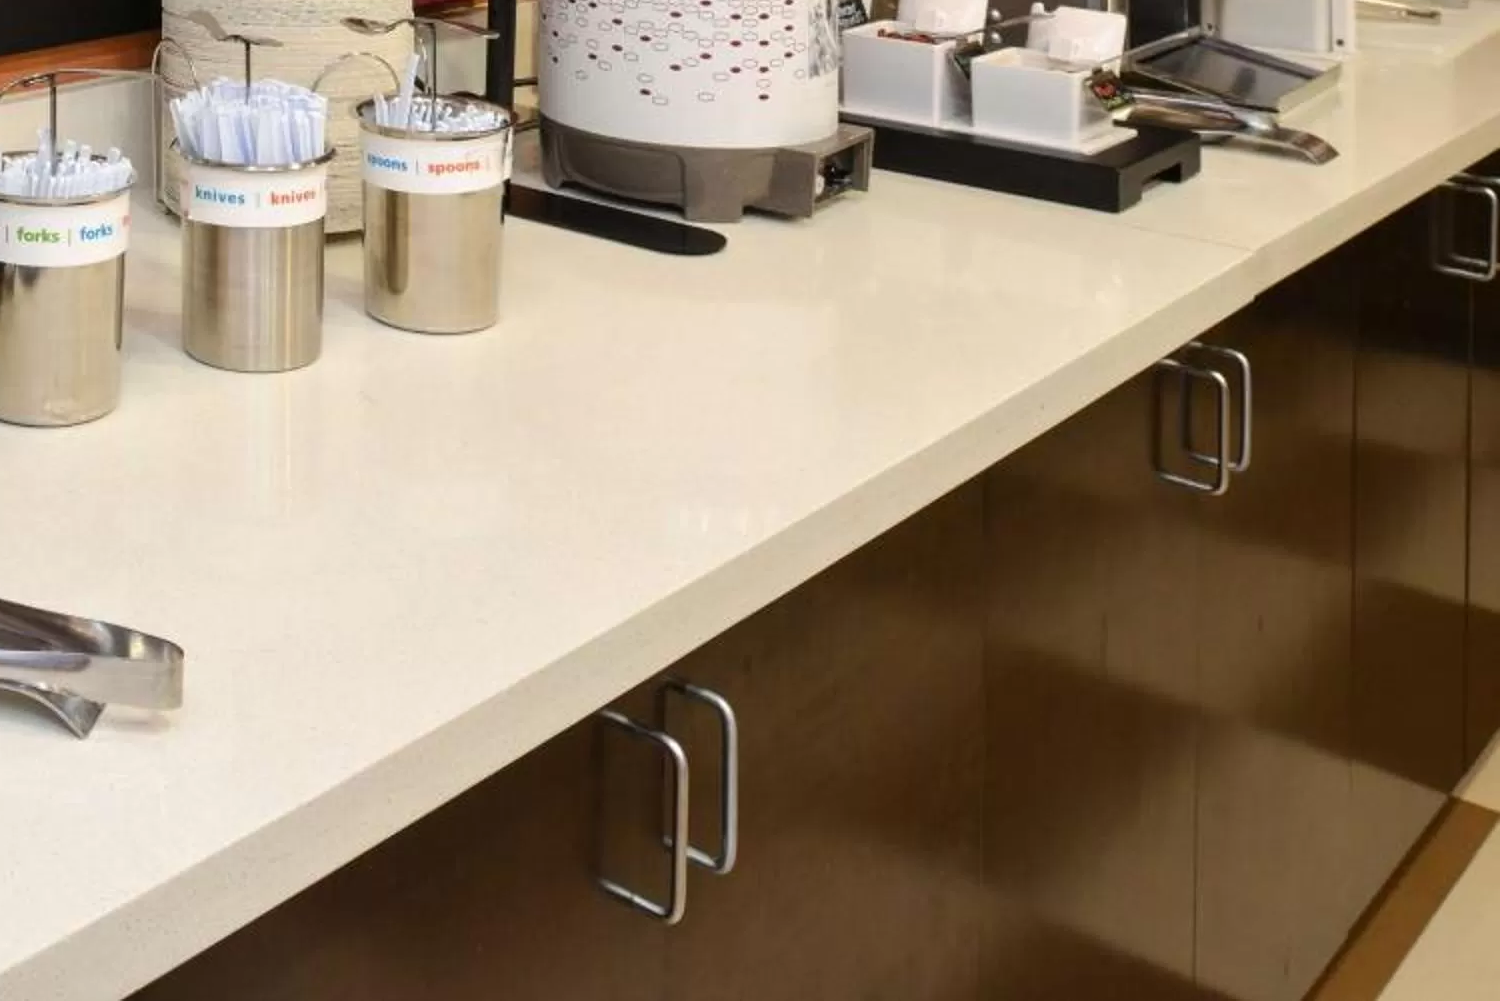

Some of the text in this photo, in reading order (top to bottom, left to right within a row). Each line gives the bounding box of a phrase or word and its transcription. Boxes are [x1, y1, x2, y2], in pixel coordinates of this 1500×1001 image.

[428, 160, 480, 176] spoons
[196, 184, 245, 204] knives
[16, 227, 60, 243] forks
[79, 223, 113, 241] forks
